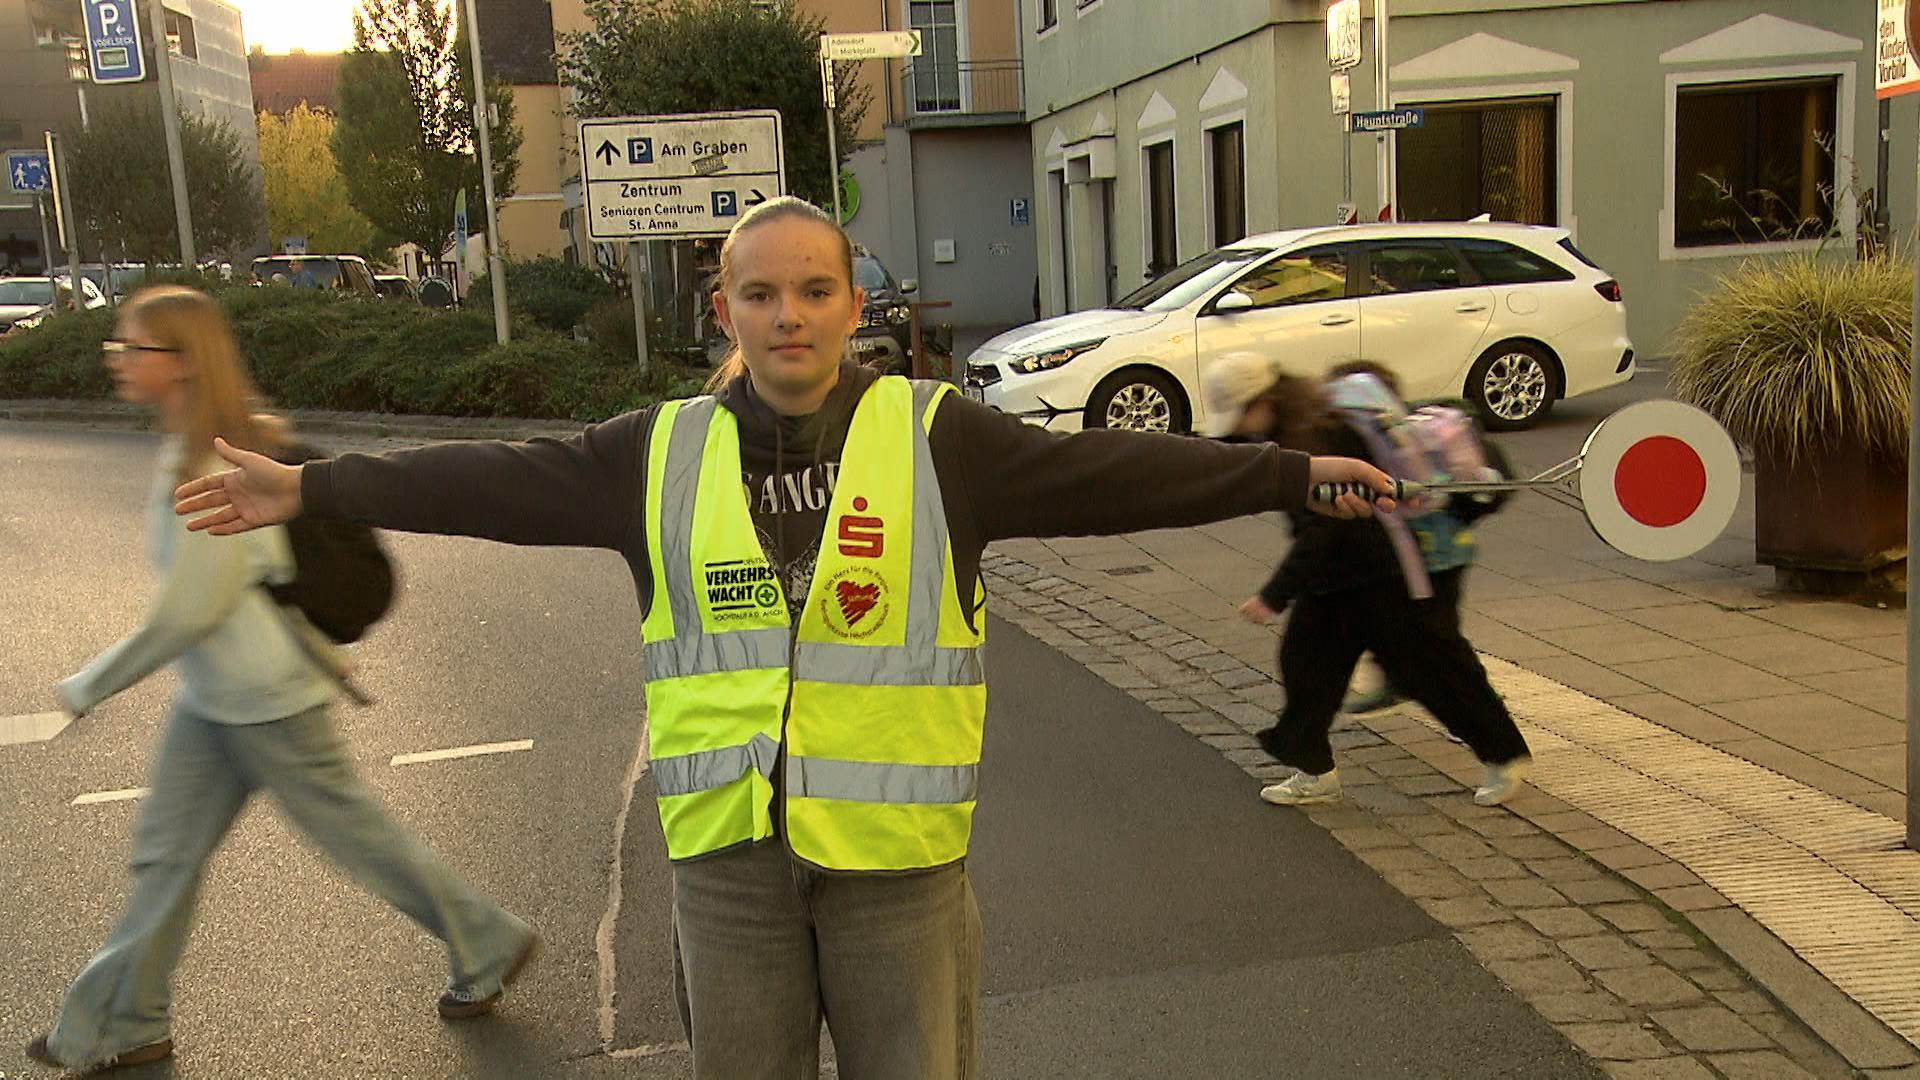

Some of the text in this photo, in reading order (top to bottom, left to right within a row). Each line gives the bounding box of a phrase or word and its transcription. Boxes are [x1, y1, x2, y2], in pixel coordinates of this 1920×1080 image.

[100, 3, 118, 36] P
[1879, 57, 1906, 83] Vorbild
[1356, 110, 1419, 128] Hauptstraße
[633, 139, 748, 160] P Am Graben
[620, 183, 682, 198] Zentrum
[601, 203, 705, 218] Senioren Centrum
[717, 195, 731, 214] P
[629, 218, 679, 231] St. Anna
[705, 567, 774, 586] VERKEHRS
[707, 585, 754, 604] WACHT
